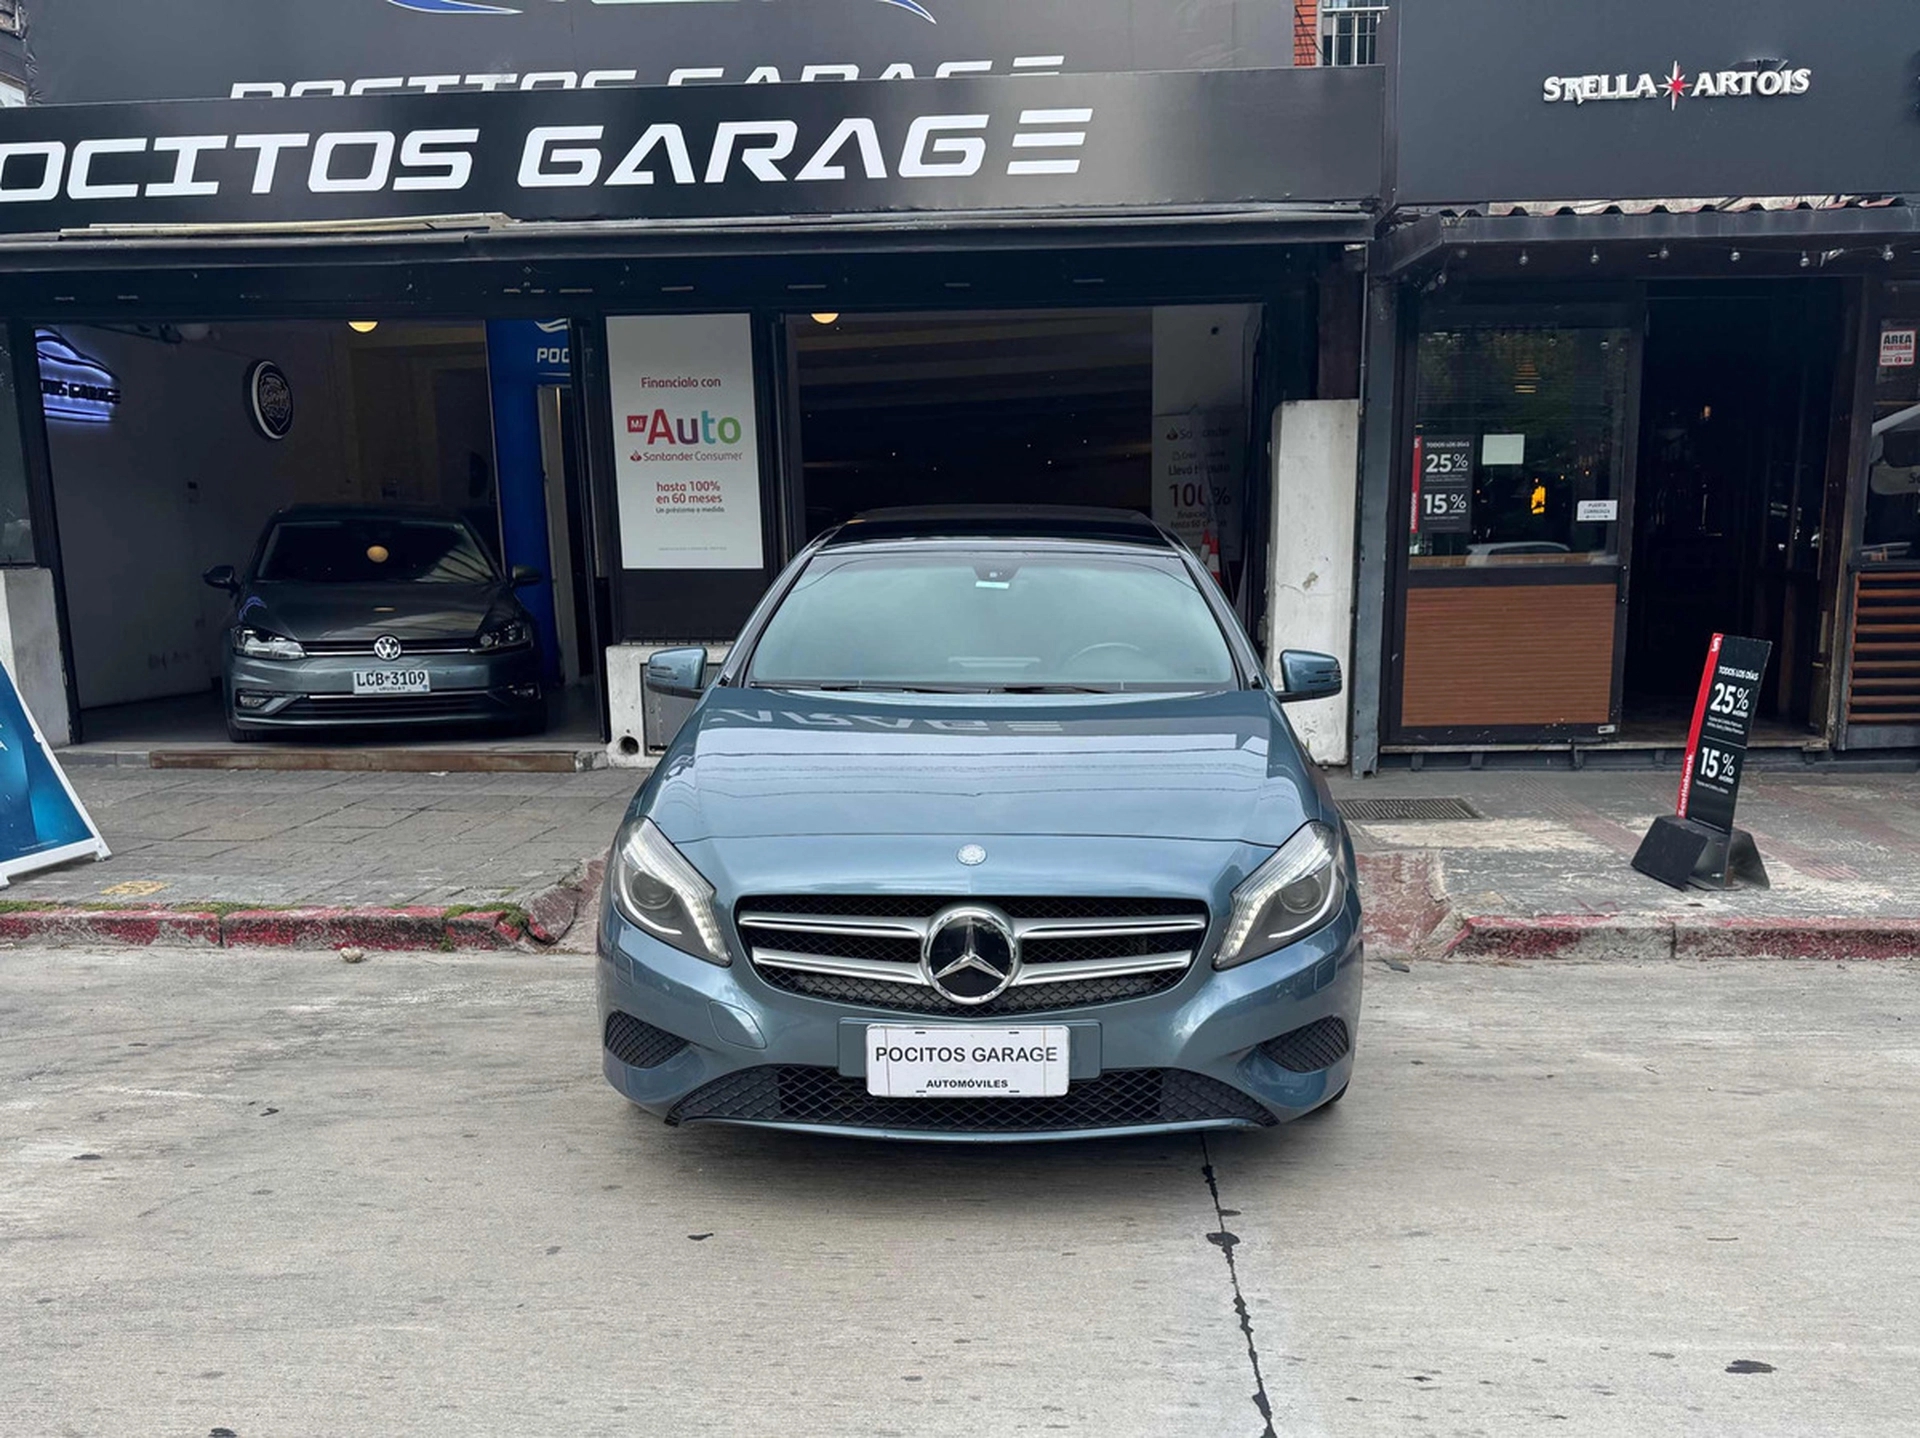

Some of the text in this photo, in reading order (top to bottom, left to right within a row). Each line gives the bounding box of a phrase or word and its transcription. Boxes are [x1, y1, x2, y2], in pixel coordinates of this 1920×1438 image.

[1543, 69, 1811, 104] STELLA ARTOIS
[516, 107, 1093, 188] GARAGE
[641, 376, 721, 388] Financialo con
[647, 408, 742, 445] Auto
[643, 451, 743, 461] Santander Consumer
[1425, 453, 1469, 473] 25%
[656, 480, 721, 492] hasta 100%
[656, 493, 723, 504] en 60 meses
[1423, 493, 1467, 514] 15%
[356, 671, 426, 686] LCB 3109
[1718, 665, 1736, 677] TODOS
[1735, 669, 1746, 679] LOS
[1710, 682, 1750, 714] 25%
[1700, 747, 1735, 778] 15%
[875, 1046, 1058, 1063] POCITOS GARAGE
[926, 1078, 1009, 1088] AUTOMÓVILES
